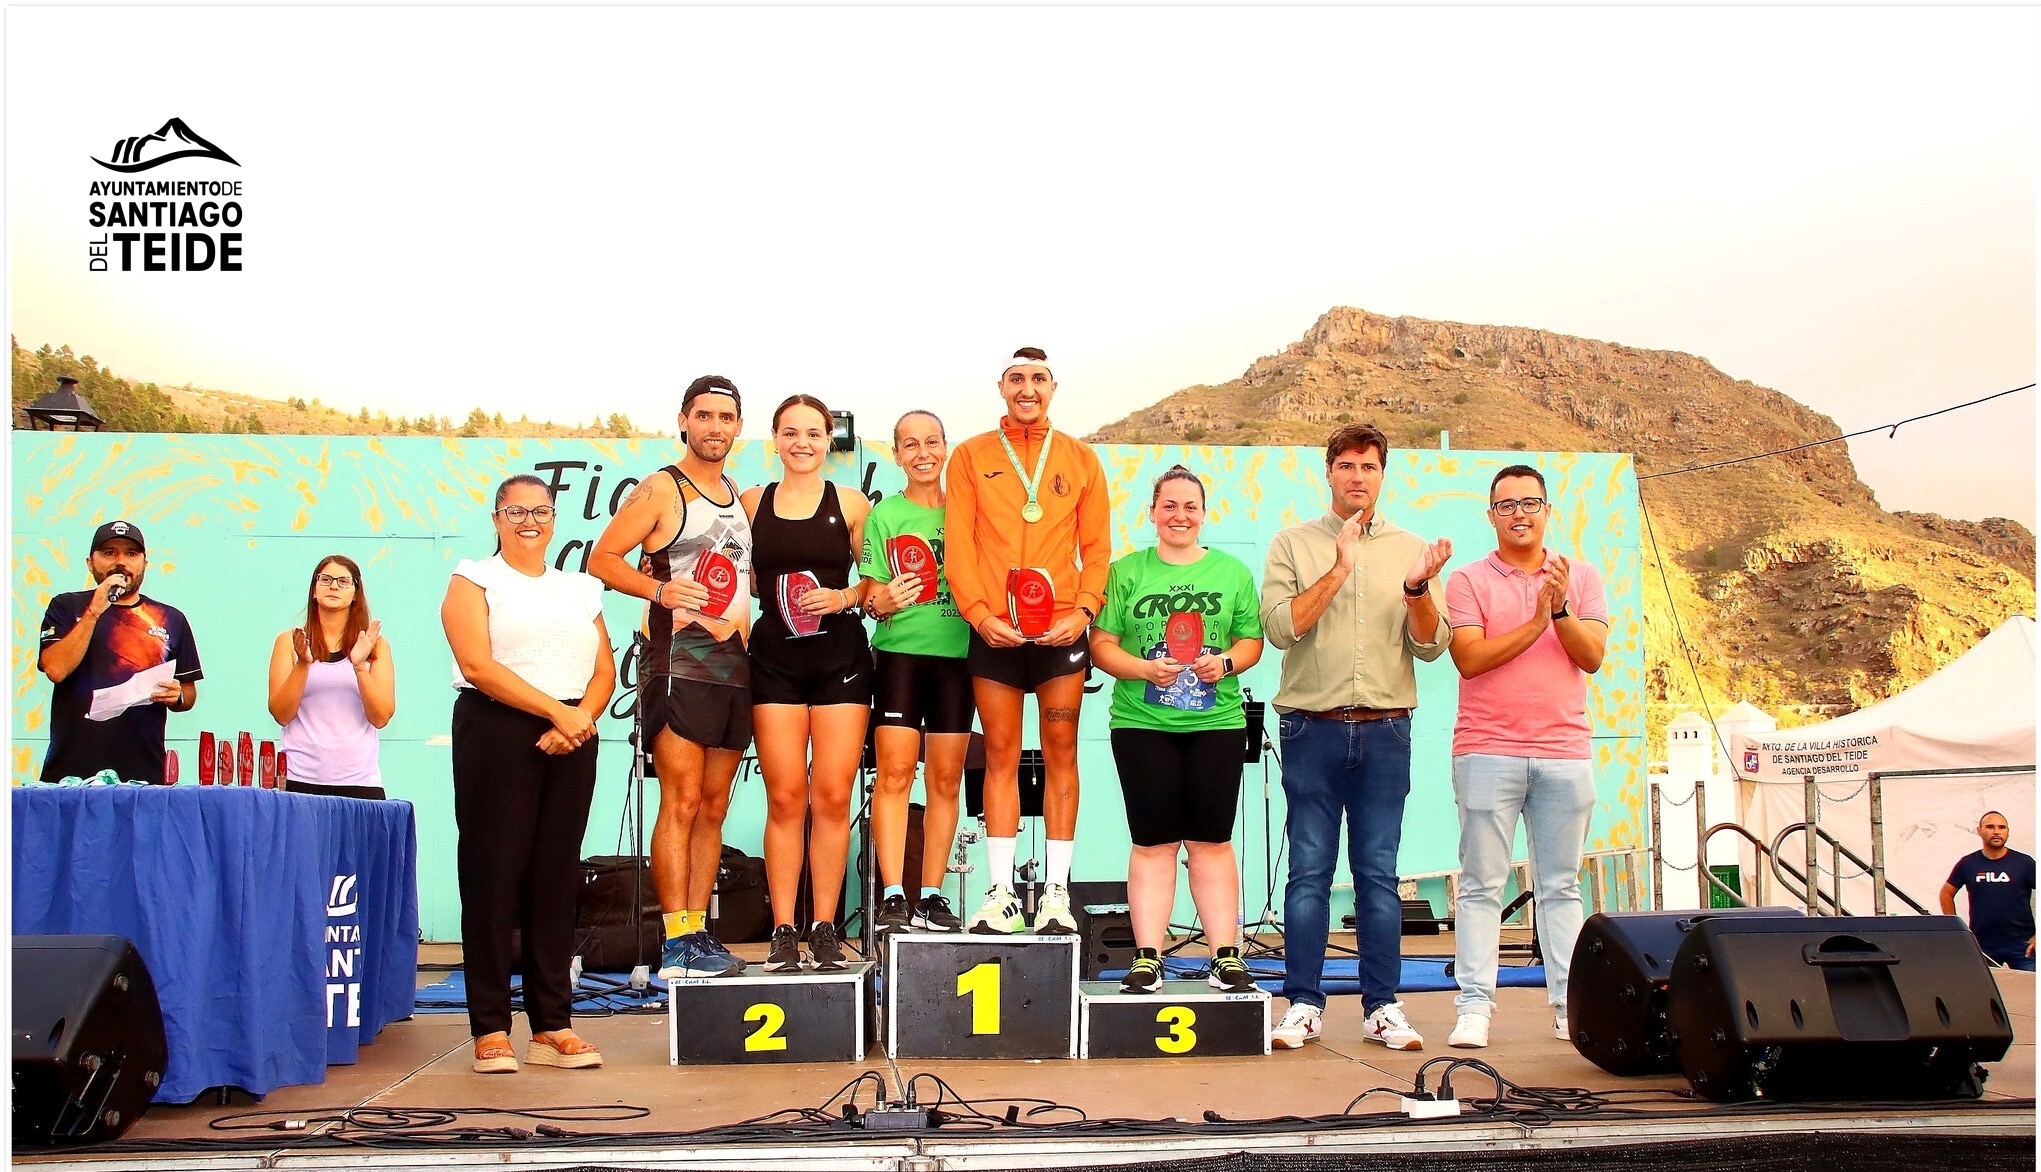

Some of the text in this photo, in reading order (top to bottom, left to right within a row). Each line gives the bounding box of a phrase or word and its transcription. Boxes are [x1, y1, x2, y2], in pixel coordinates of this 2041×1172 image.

[1169, 584, 1194, 592] XXXI
[1132, 592, 1223, 619] CROSS
[1784, 742, 1796, 751] DE
[1797, 742, 1808, 751] LA
[1809, 740, 1831, 750] VILLA
[1772, 750, 1868, 764] DE SANTIAGO DEL TEIDE
[1782, 764, 1859, 775] AGENCIA DESARROLLO
[1975, 871, 2011, 883] FILA
[957, 963, 1000, 1034] 1
[744, 1003, 787, 1052] 2
[1155, 1006, 1197, 1053] 3
